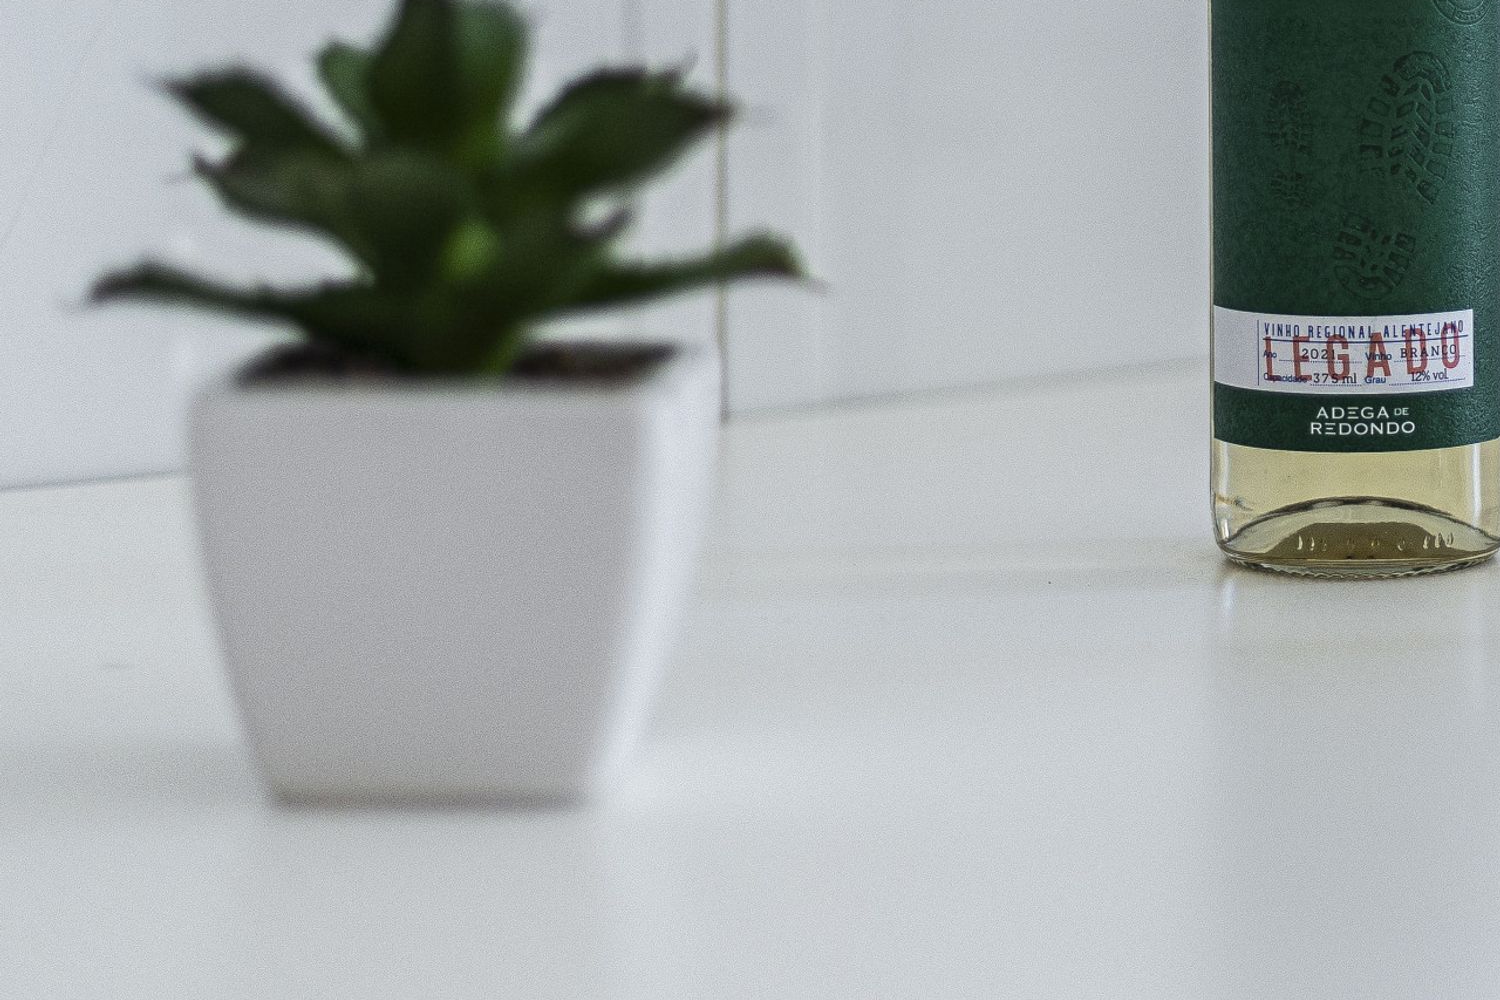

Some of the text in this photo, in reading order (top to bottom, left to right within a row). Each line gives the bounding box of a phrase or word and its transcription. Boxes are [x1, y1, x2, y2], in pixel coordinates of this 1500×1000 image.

[1264, 319, 1464, 339] VINHO REGIONAL ALENTEJANO
[1264, 323, 1461, 382] LEGADO
[1301, 348, 1336, 360] 2021
[1365, 344, 1457, 362] Vinho BRANCO
[1313, 372, 1339, 384] 375
[1342, 372, 1358, 384] ml
[1364, 368, 1449, 384] Grau 12% vol
[1316, 406, 1410, 420] ADEGA DE
[1310, 421, 1416, 436] REDONDO
